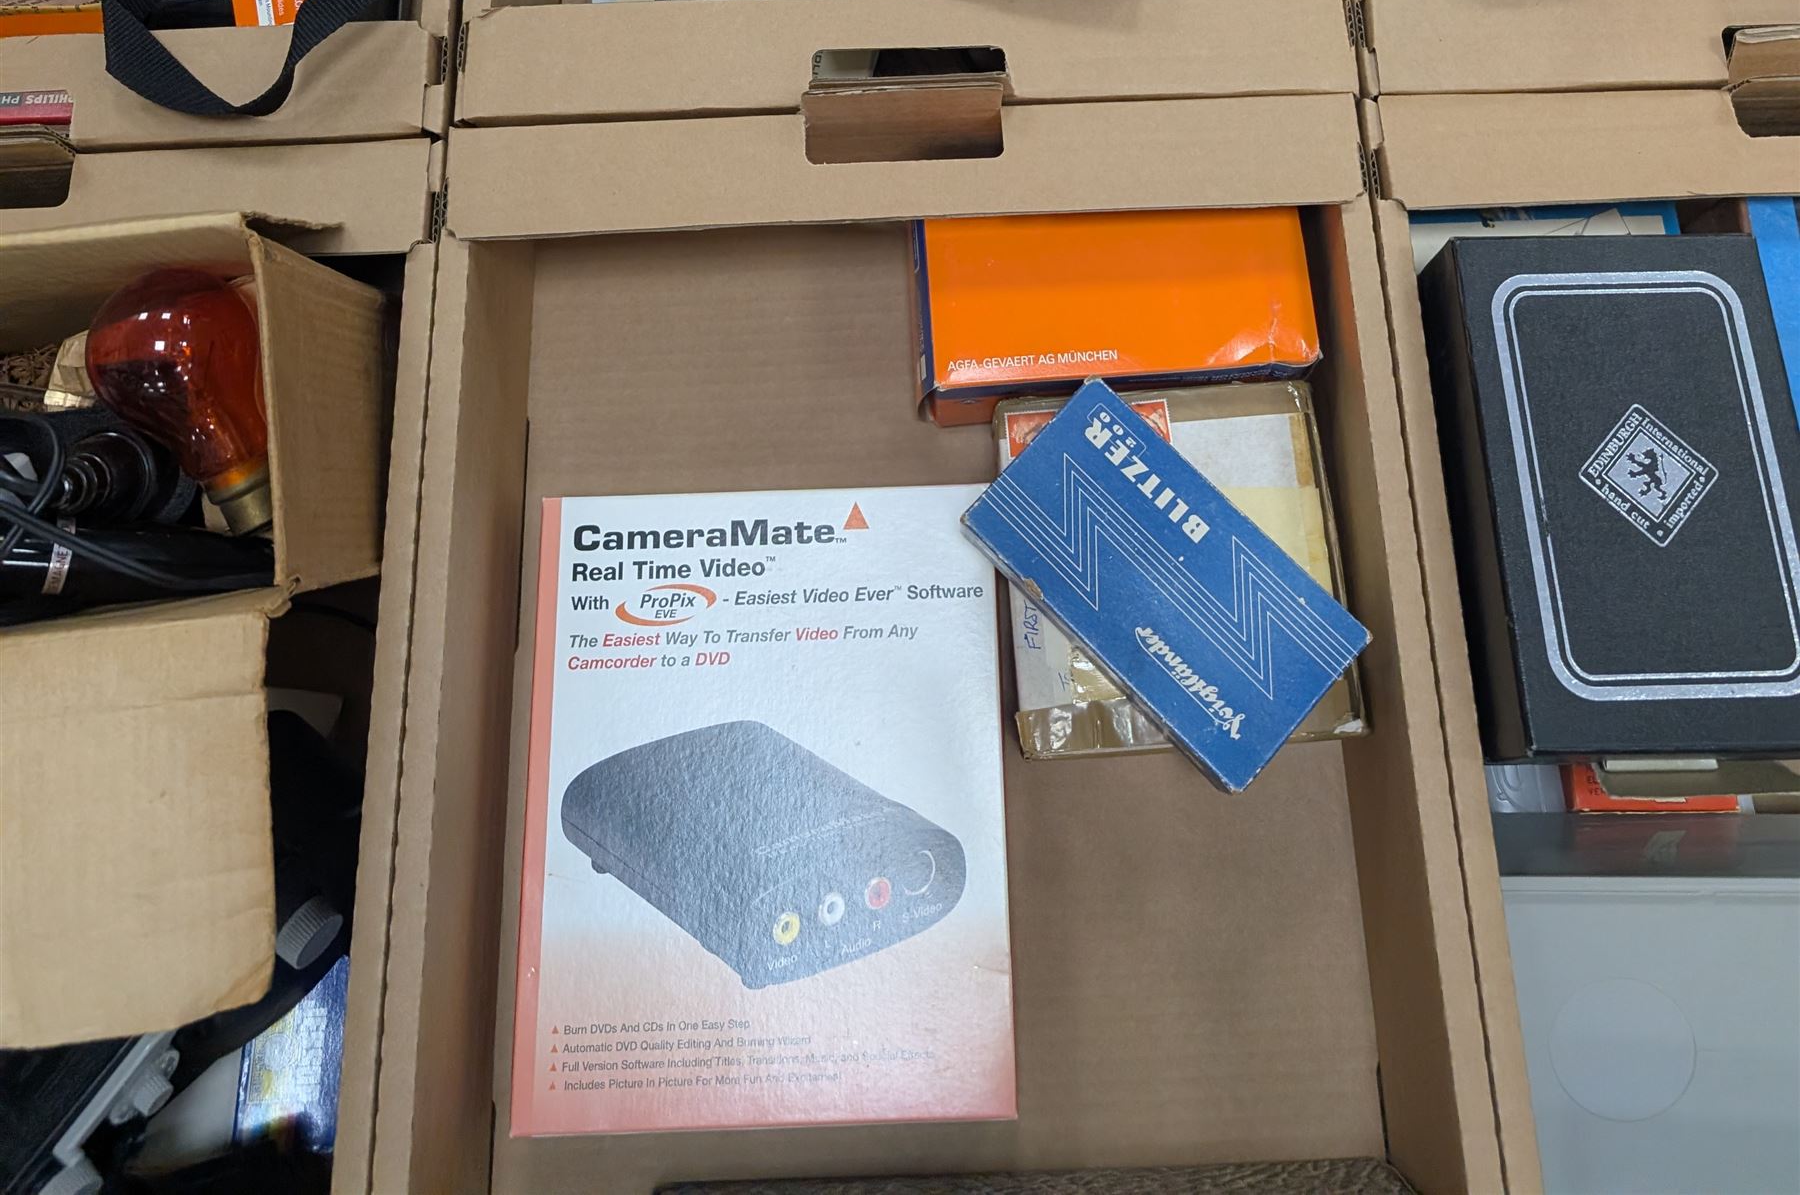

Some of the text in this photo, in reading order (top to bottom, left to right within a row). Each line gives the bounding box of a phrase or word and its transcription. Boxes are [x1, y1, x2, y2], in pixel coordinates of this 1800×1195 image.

[947, 349, 1118, 372] AGFA-GEVAERT AG MÜNCHEN
[1100, 411, 1137, 448] 200
[1587, 412, 1642, 479] EDINBURGH
[1640, 417, 1710, 476] International
[1084, 417, 1211, 544] BLITZER
[1601, 484, 1651, 530] hand cut
[1663, 480, 1704, 530] imported
[571, 562, 624, 582] Real
[632, 560, 692, 580] Time
[571, 596, 610, 611] With
[640, 593, 697, 609] ProPix
[734, 589, 797, 606] Easiest
[802, 588, 850, 604] Video
[906, 584, 984, 600] Software
[654, 609, 678, 619] EVE
[1023, 600, 1042, 650] FIRST
[569, 624, 919, 648] The Easiest Way To Transfer Video From Any
[567, 652, 731, 670] Camcorder to a DVD
[872, 919, 881, 932] R
[840, 936, 872, 956] Audio
[767, 953, 798, 972] Video
[563, 1018, 750, 1035] Burn DVDs And CDs In One Easy Step
[562, 1043, 613, 1054] Automatic
[615, 1041, 638, 1052] DVD
[640, 1039, 675, 1051] Quality
[677, 1037, 711, 1050] Editing
[713, 1037, 734, 1048] And
[562, 1062, 580, 1073] Full
[582, 1060, 618, 1071] Version
[621, 1058, 665, 1070] Software
[667, 1057, 712, 1069] Including
[564, 1080, 606, 1091] Includes
[608, 1078, 643, 1089] Picture
[646, 1077, 655, 1088] In
[658, 1076, 693, 1088] Picture
[696, 1076, 713, 1087] For
[715, 1075, 740, 1086] More
[743, 1074, 762, 1084] Fun
